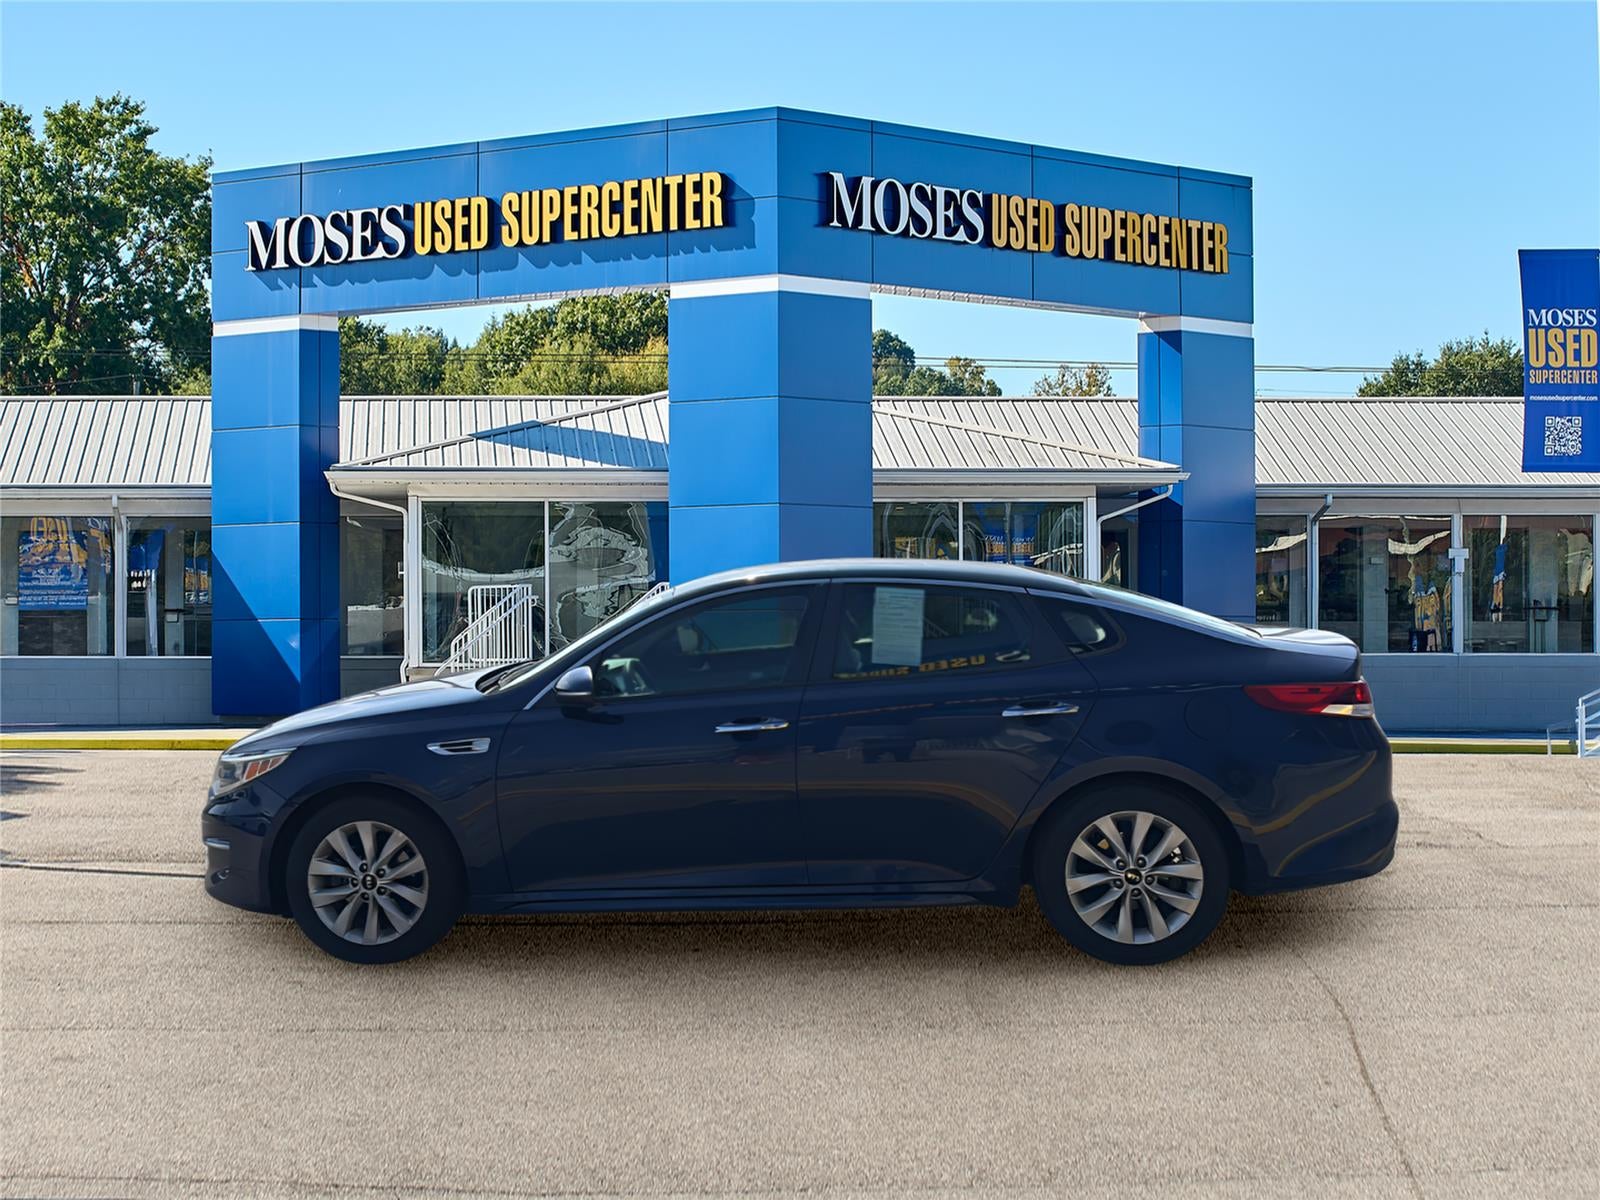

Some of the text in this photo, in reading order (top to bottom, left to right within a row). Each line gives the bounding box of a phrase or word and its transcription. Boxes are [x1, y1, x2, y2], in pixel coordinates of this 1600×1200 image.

[245, 171, 723, 272] MOSES USED SUPERCENTER
[828, 171, 1229, 274] MOSES USED SUPERCENTER
[1528, 308, 1597, 327] MOSES
[1528, 328, 1598, 368] USED
[1529, 369, 1598, 385] SUPERCENTER
